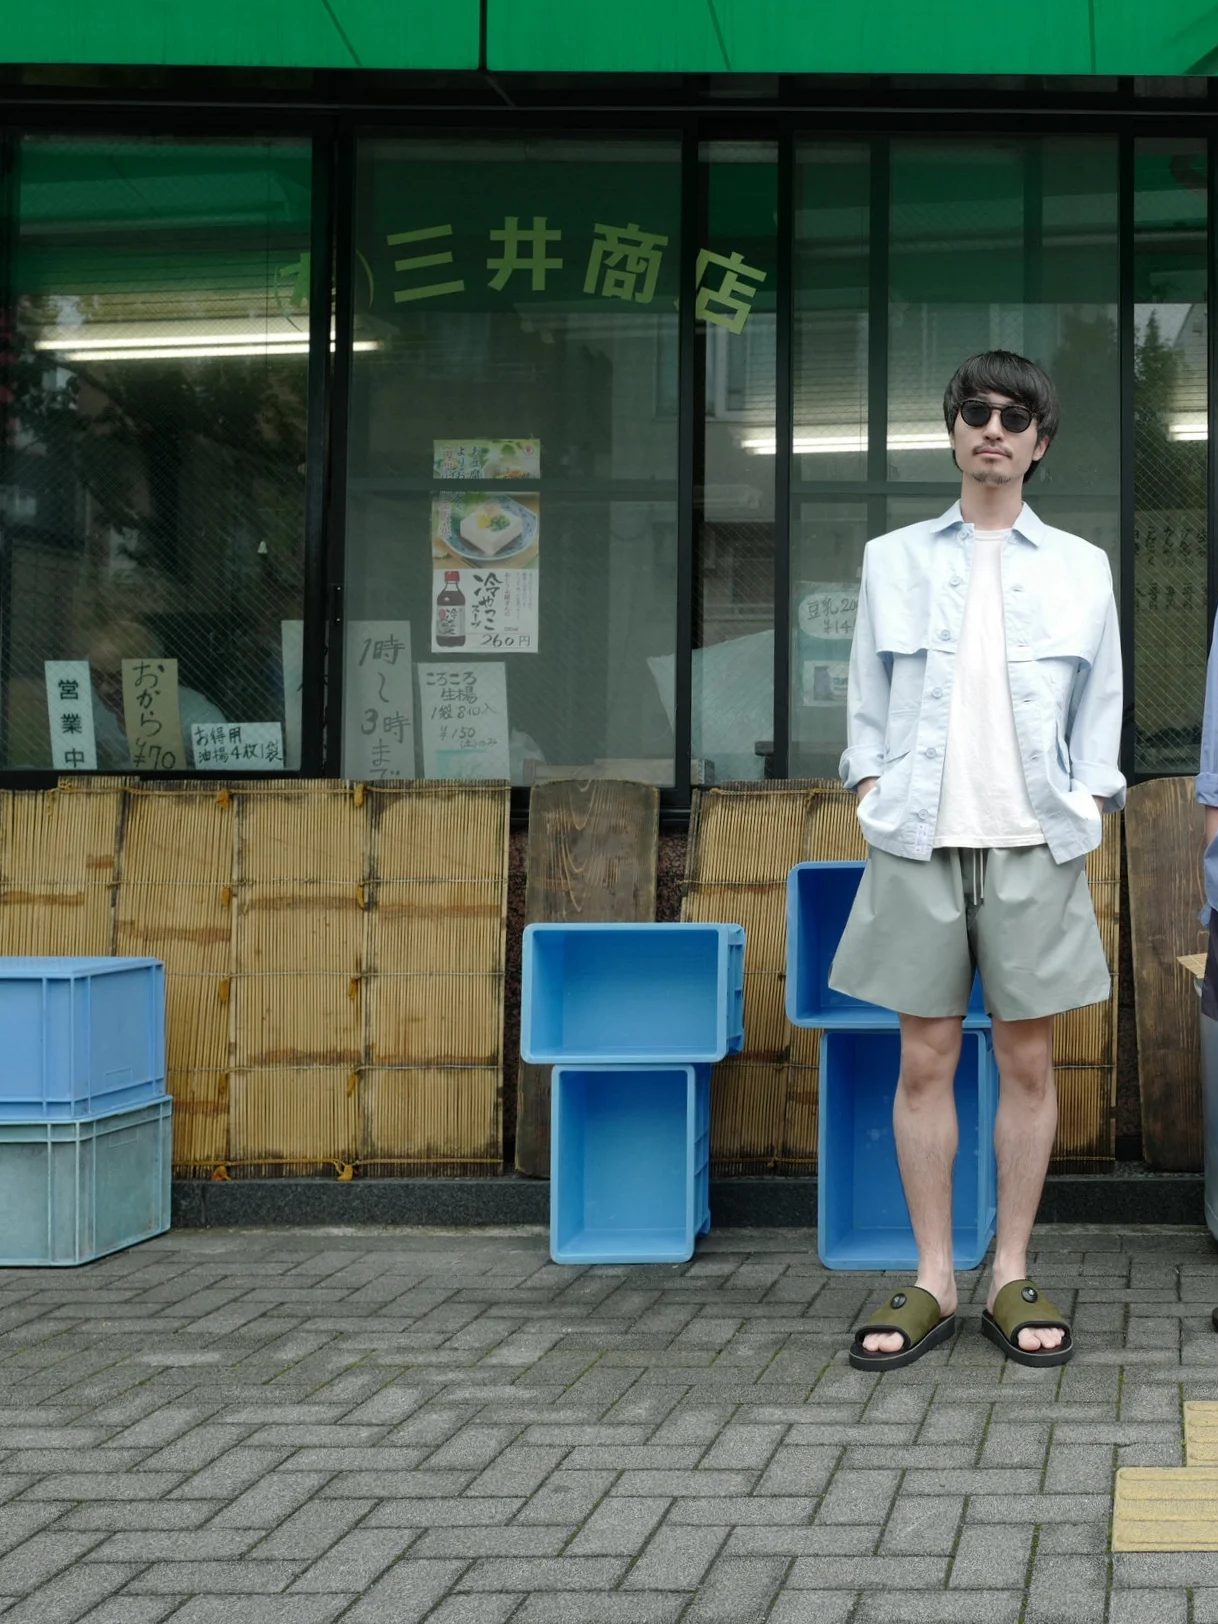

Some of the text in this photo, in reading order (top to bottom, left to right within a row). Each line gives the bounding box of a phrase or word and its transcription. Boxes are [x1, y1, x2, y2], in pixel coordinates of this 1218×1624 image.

[386, 216, 767, 335] 三井商店
[823, 618, 856, 636] ¥14
[481, 633, 531, 648] 260円
[425, 671, 478, 686] ころころ
[132, 661, 166, 738] おから
[58, 679, 85, 768] 営業中
[439, 725, 476, 741] ¥150
[132, 738, 176, 769] ¥70
